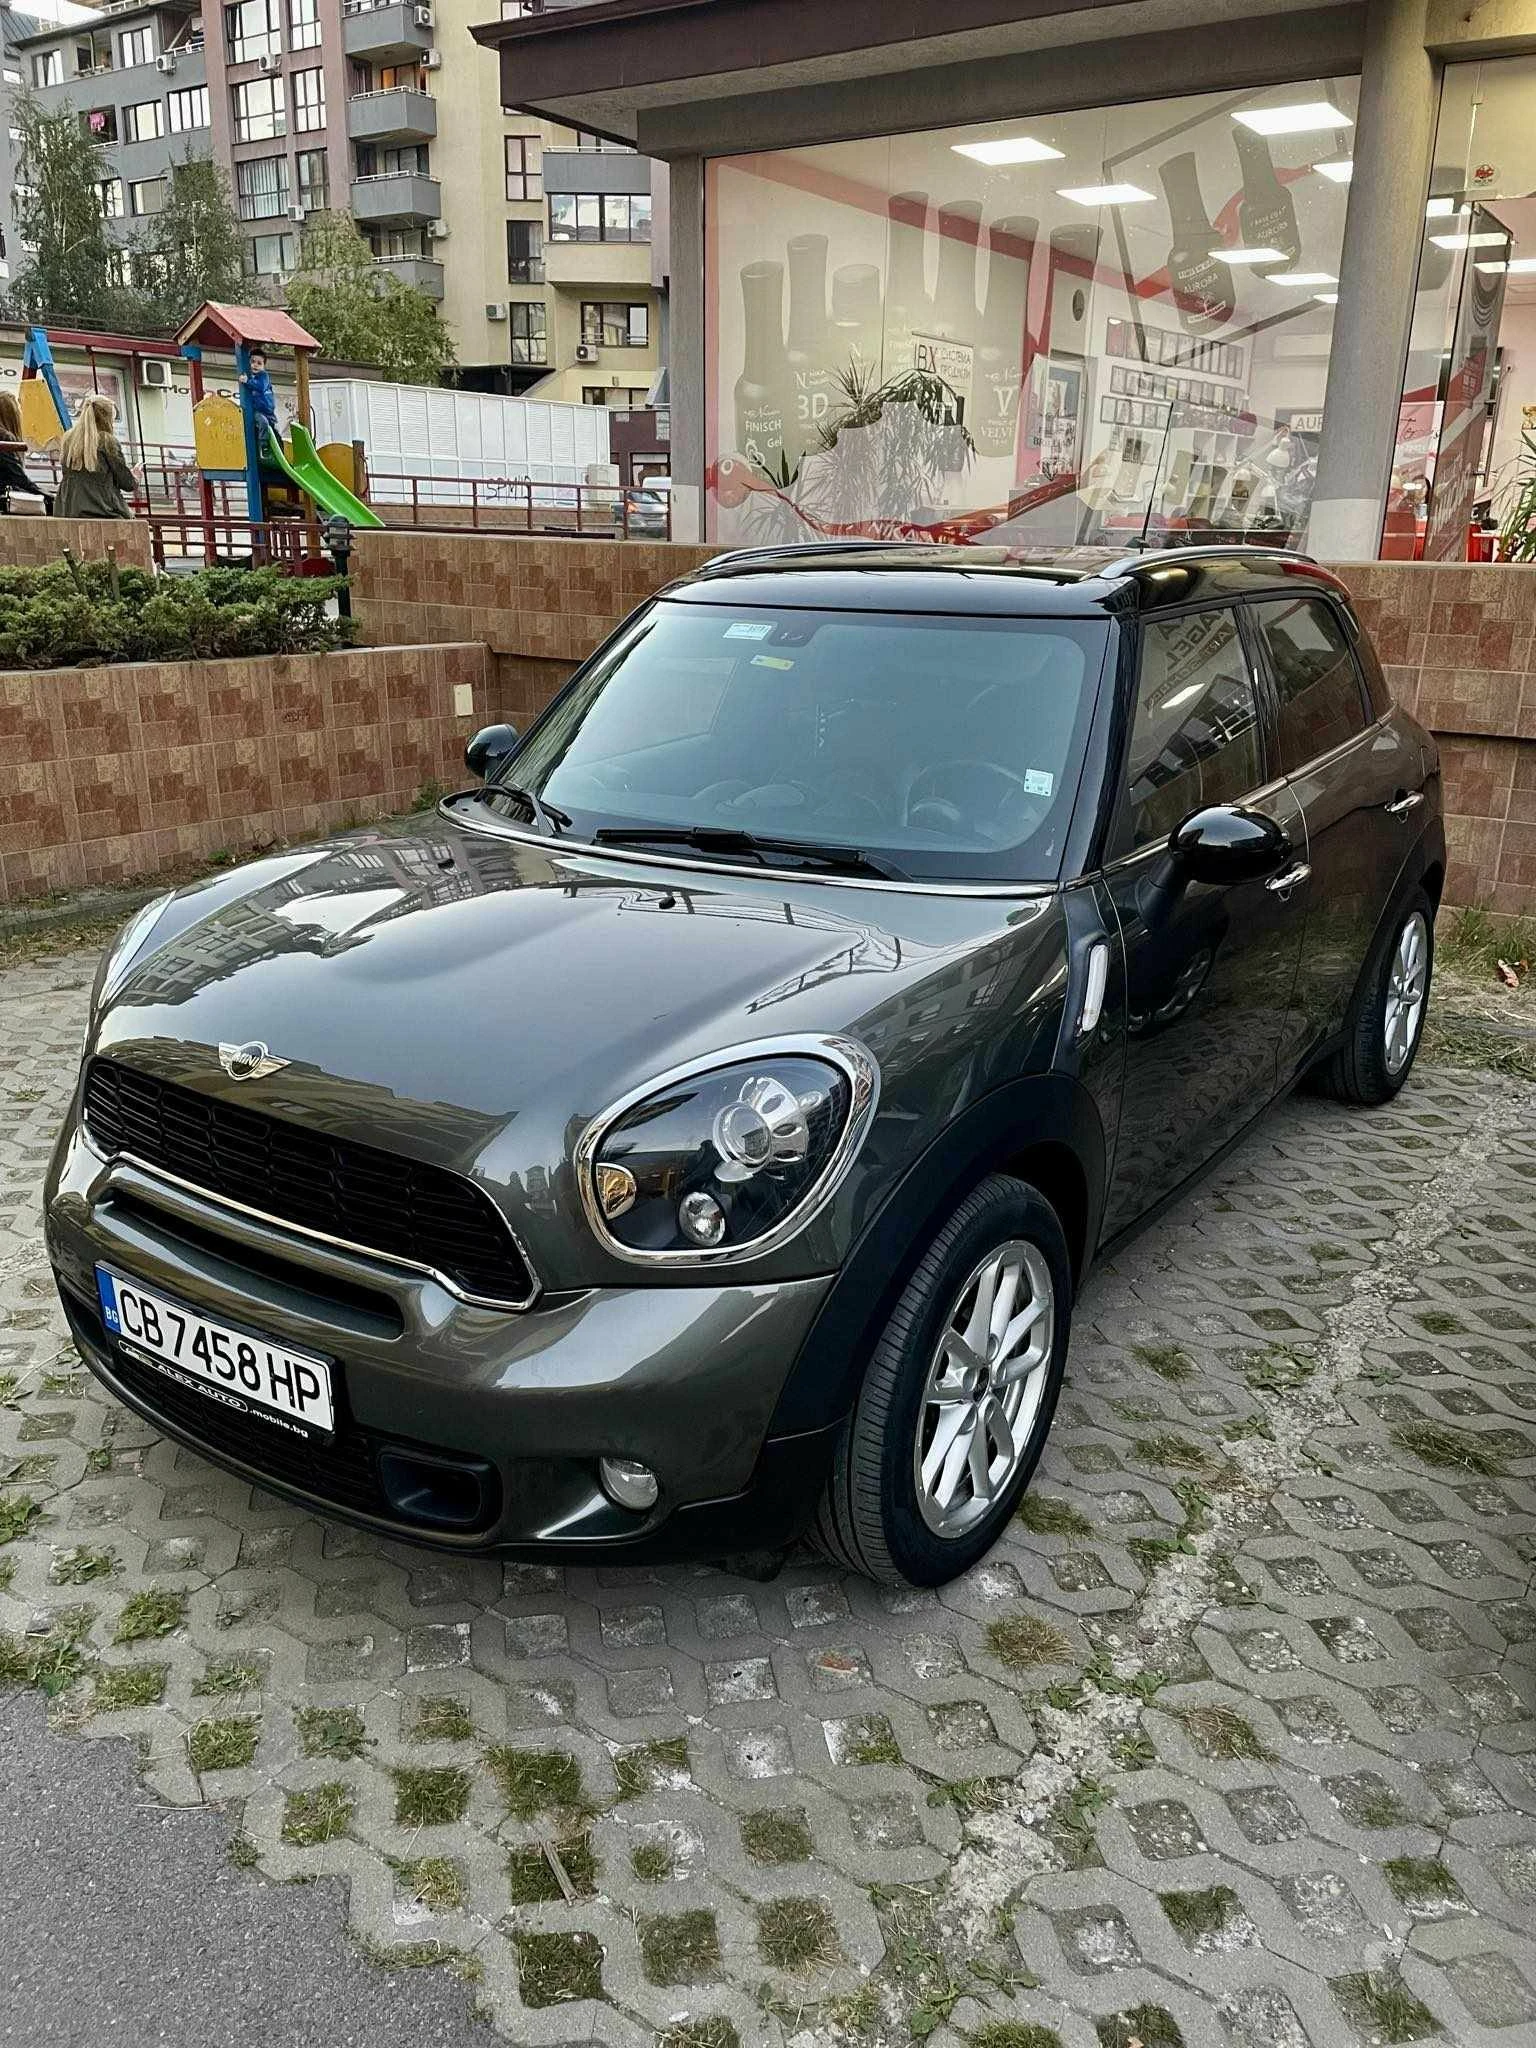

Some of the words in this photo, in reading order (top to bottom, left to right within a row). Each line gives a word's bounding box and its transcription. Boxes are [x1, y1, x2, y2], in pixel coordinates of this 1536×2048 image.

[1184, 272, 1219, 295] AURORA
[797, 392, 829, 421] 3D
[105, 1305, 118, 1325] BG
[119, 1289, 163, 1348] CB
[167, 1311, 261, 1392] 7458
[266, 1352, 320, 1412] HP
[158, 1364, 194, 1388] ALEX
[198, 1385, 241, 1408] AUTO
